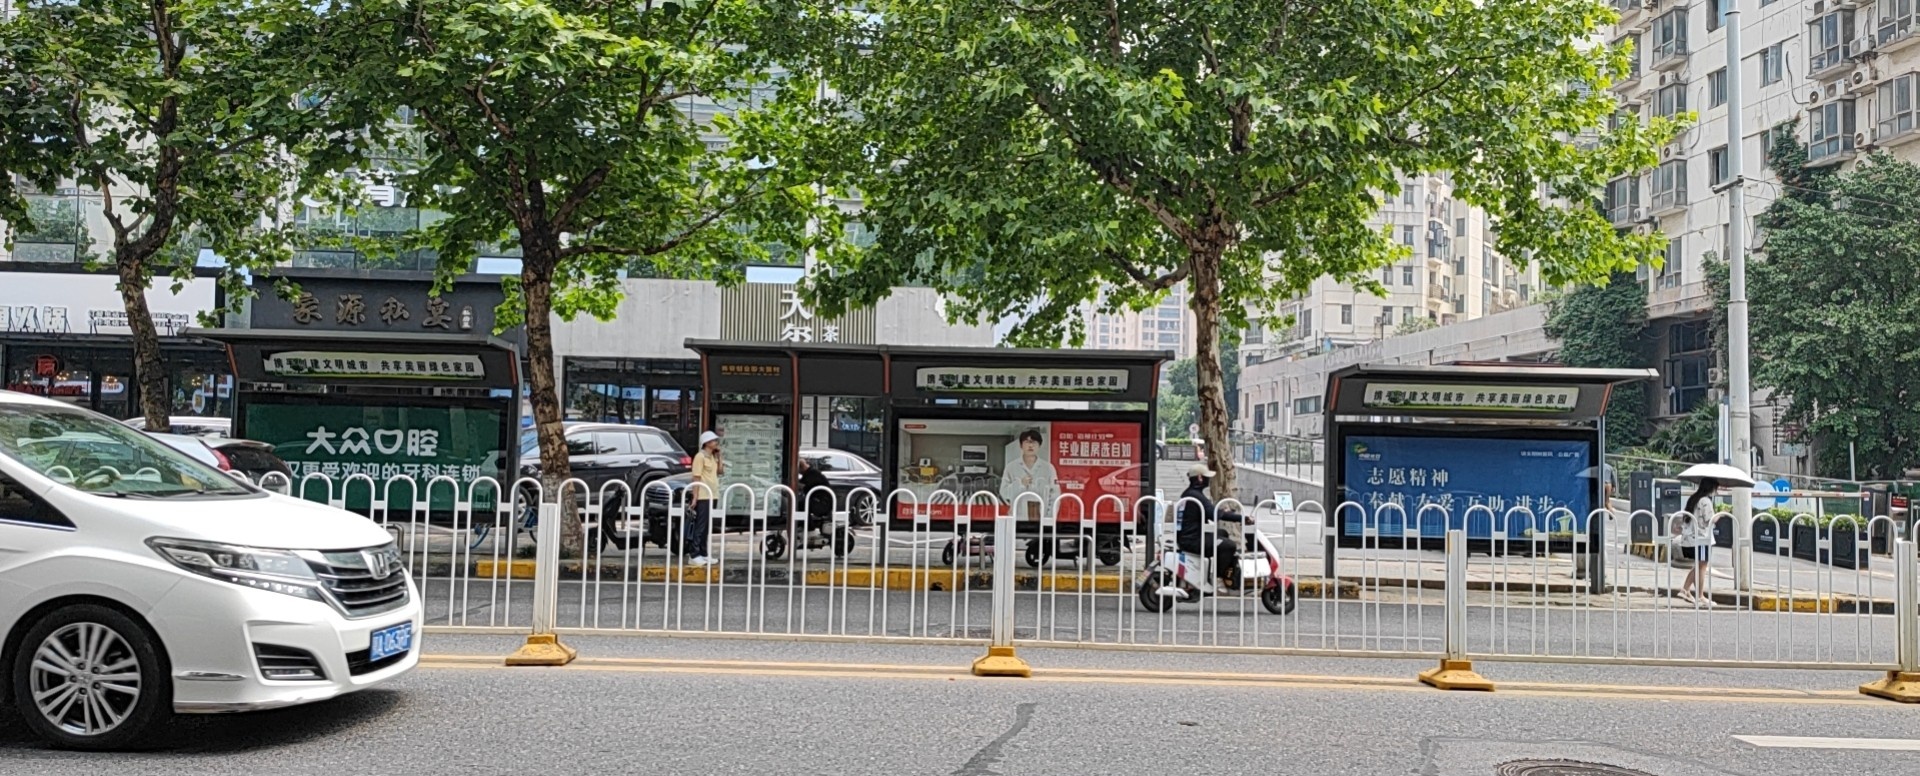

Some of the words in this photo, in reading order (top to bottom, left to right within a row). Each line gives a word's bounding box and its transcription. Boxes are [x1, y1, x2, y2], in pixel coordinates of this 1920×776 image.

[293, 291, 452, 329] 家源私宴
[380, 360, 474, 373] 共享美丽绿色家园
[1027, 375, 1118, 387] 共享美丽绿色家园
[1475, 391, 1568, 405] 共享美丽绿色家园
[305, 425, 439, 457] 大众口腔
[1059, 441, 1132, 458] 毕业租房选自如
[1367, 467, 1449, 487] 志愿精神
